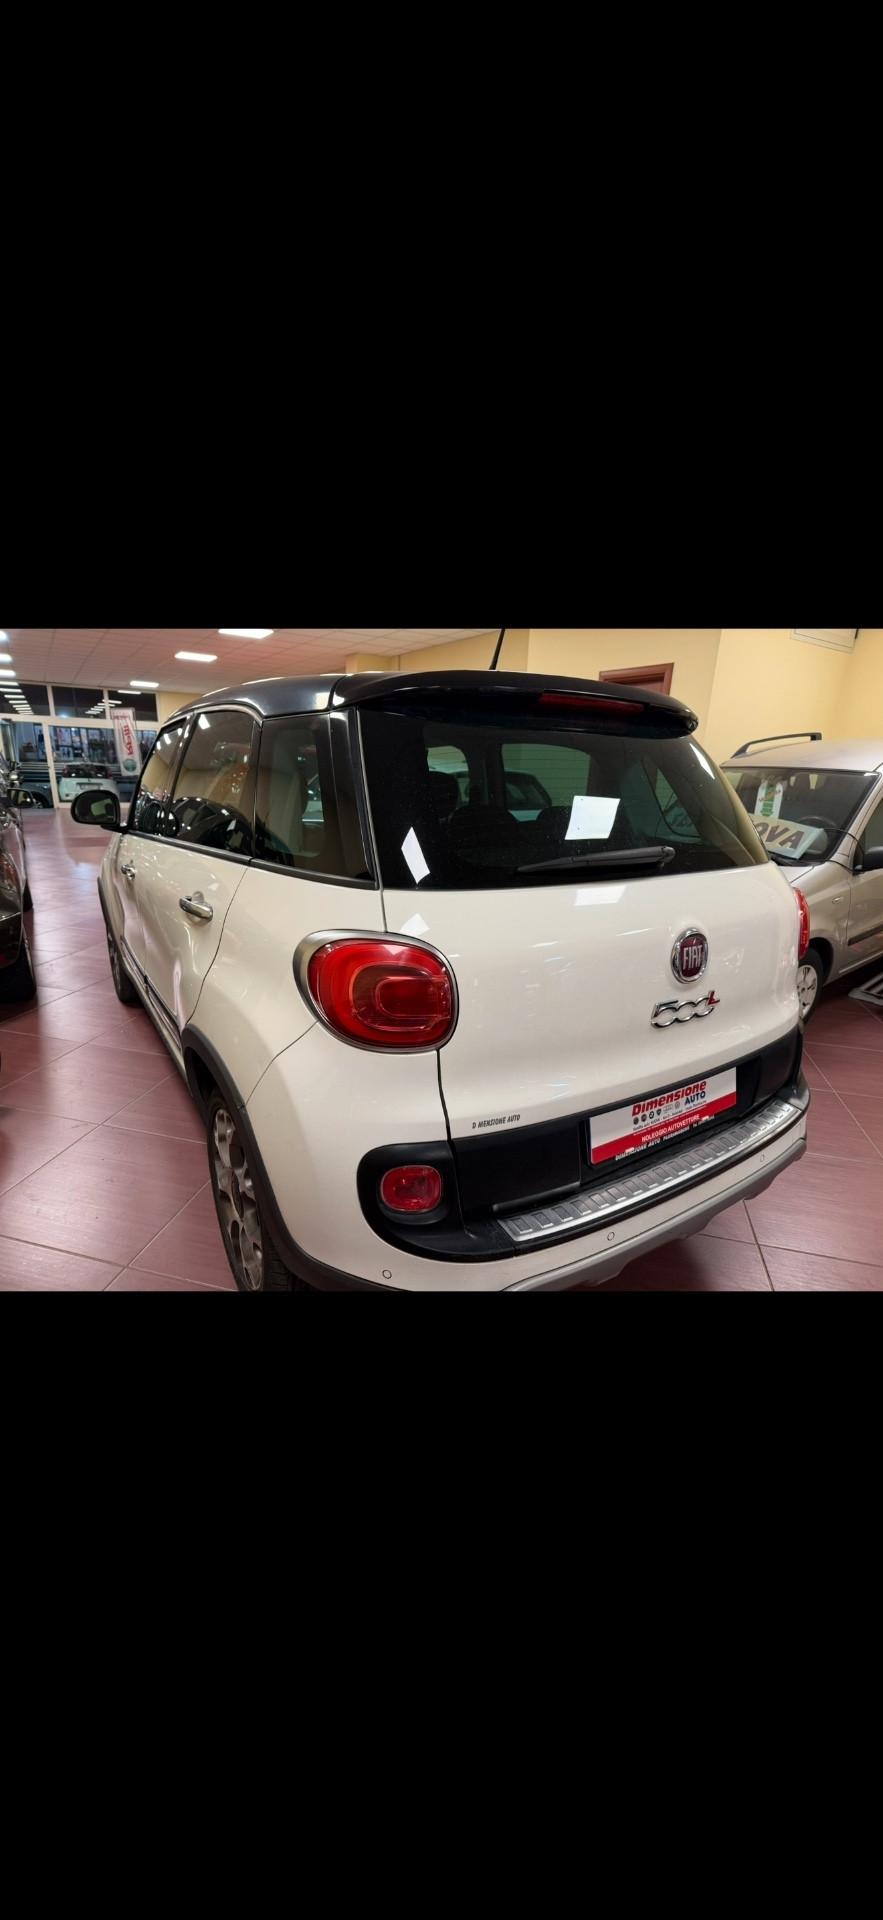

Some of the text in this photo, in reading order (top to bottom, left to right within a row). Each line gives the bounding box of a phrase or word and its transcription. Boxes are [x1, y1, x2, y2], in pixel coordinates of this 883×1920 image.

[683, 944, 703, 970] FIAT
[650, 990, 721, 1028] 500L
[632, 1081, 706, 1116] Dimensione
[684, 1091, 706, 1105] AUTO
[507, 1114, 520, 1123] AUTO
[641, 1127, 667, 1142] NOLEGGIO
[667, 1114, 700, 1131] AUTOVETTURE
